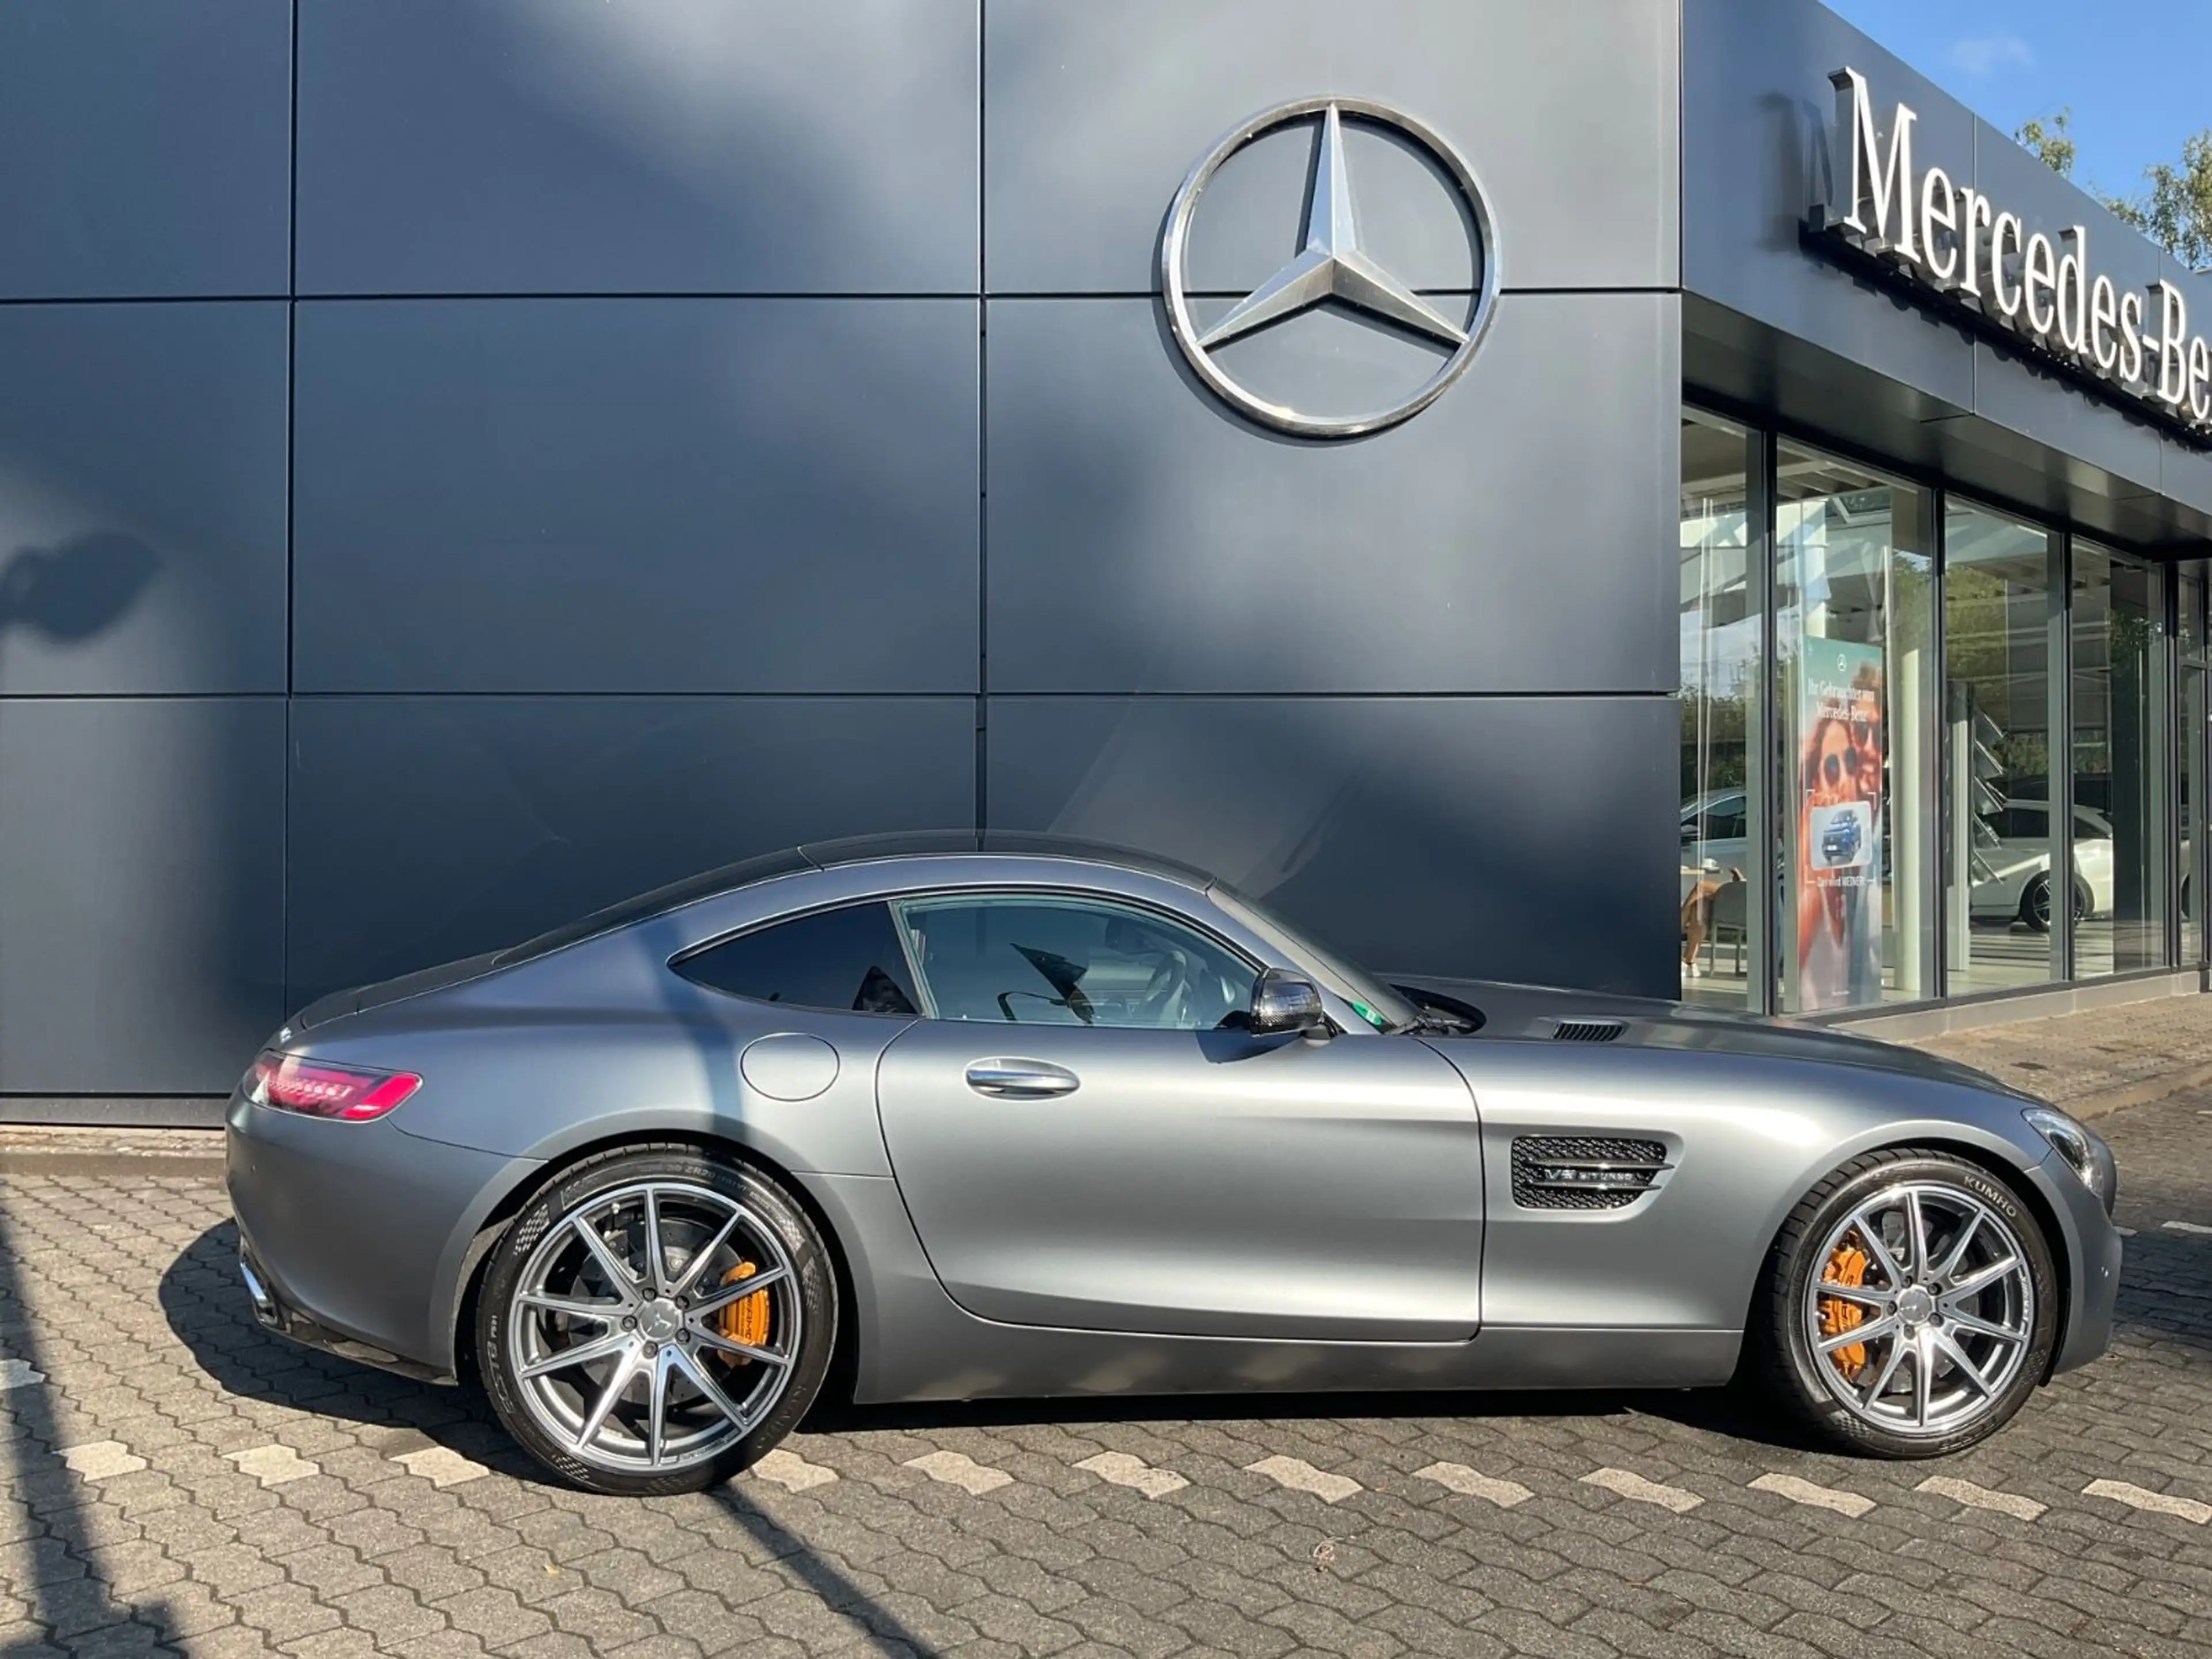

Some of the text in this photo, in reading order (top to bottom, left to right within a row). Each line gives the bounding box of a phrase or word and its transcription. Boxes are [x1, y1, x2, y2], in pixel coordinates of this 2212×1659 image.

[1843, 66, 2212, 423] Mercedes-Be
[1544, 1169, 1577, 1180] V8
[1963, 1176, 2017, 1217] KUMHO
